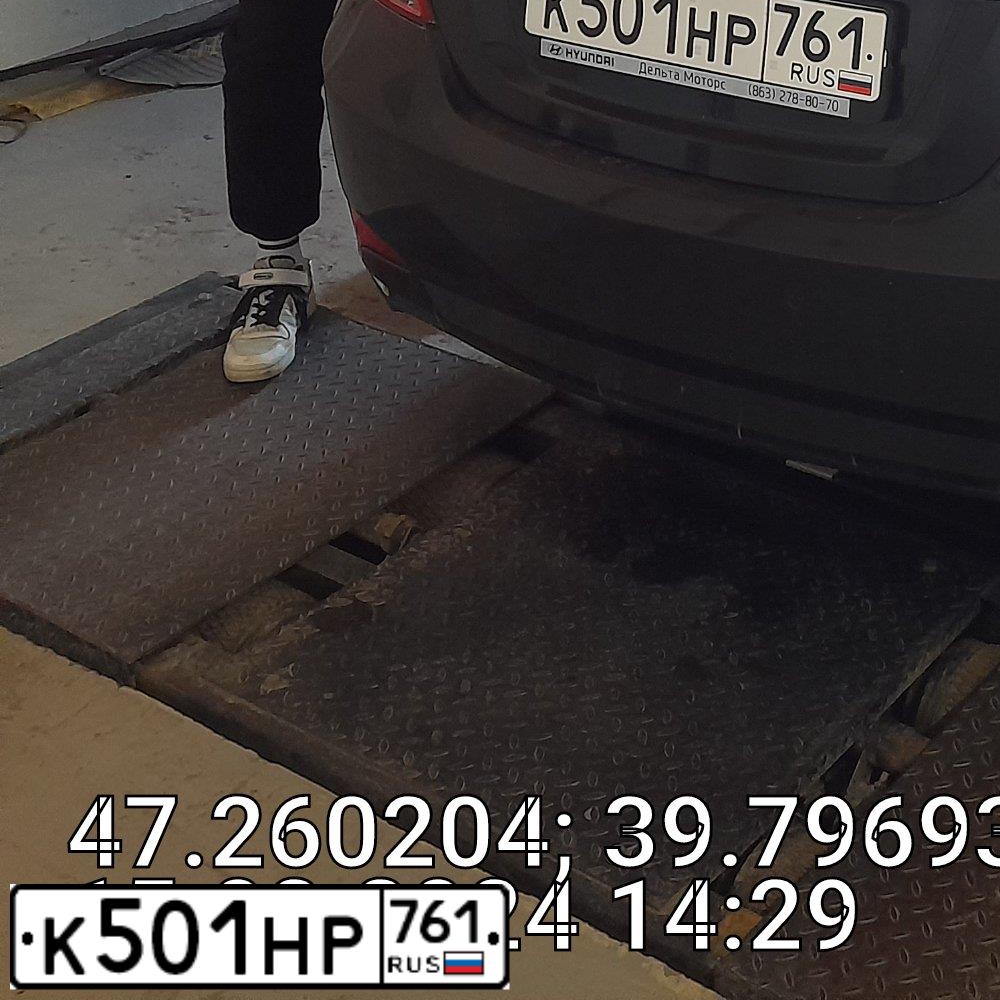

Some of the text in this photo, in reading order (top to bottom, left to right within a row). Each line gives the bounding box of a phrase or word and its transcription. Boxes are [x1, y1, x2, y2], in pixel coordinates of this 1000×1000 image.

[773, 4, 865, 69] 761
[565, 48, 615, 67] HYUNDAI
[790, 62, 835, 87] RUS
[638, 62, 839, 112] Дельта Моторс (863) 278-80-70
